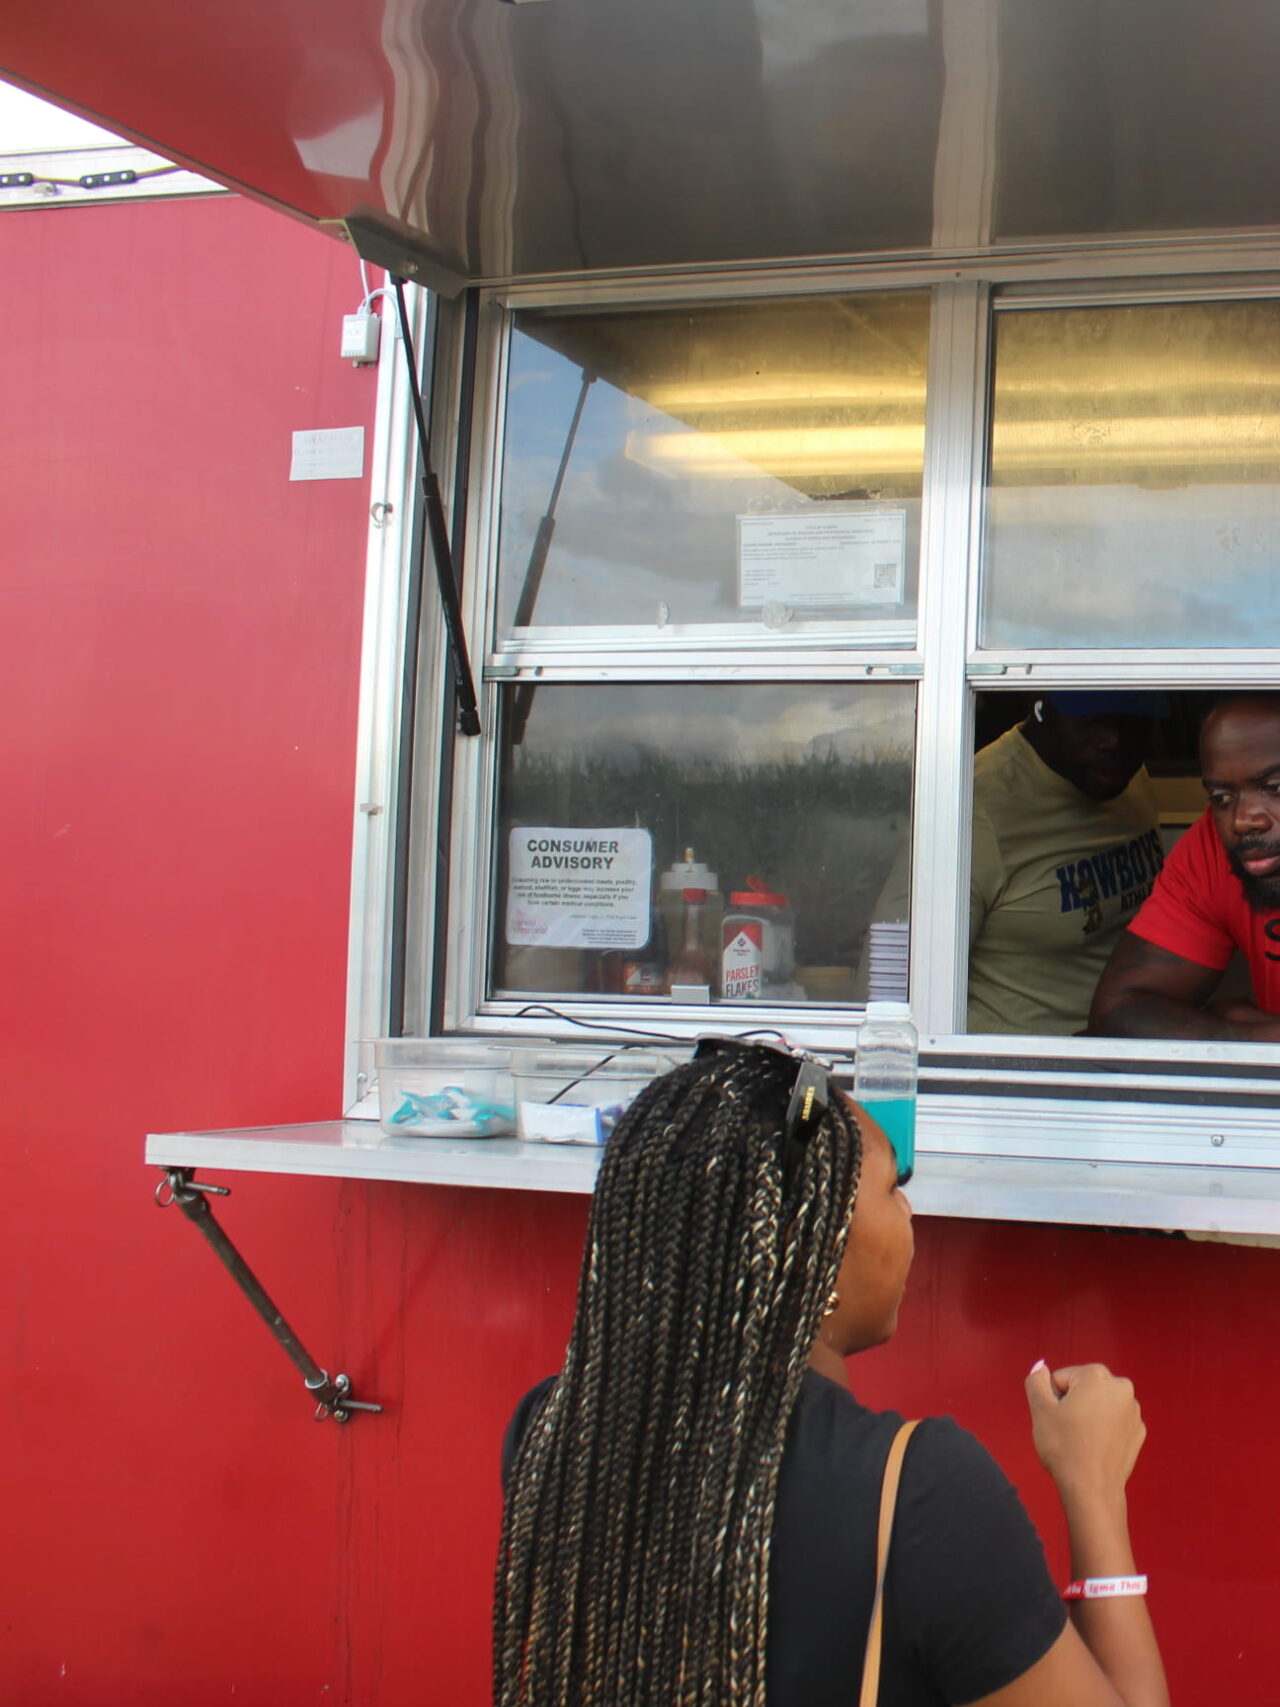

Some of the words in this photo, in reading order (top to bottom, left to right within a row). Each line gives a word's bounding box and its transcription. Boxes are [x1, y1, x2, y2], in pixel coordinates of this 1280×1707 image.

[527, 839, 619, 854] CONSUMER
[530, 855, 614, 870] ADVISORY
[1056, 829, 1164, 913] KOWBOYS
[725, 965, 760, 983] PARSLEY
[725, 978, 760, 998] FLAKES
